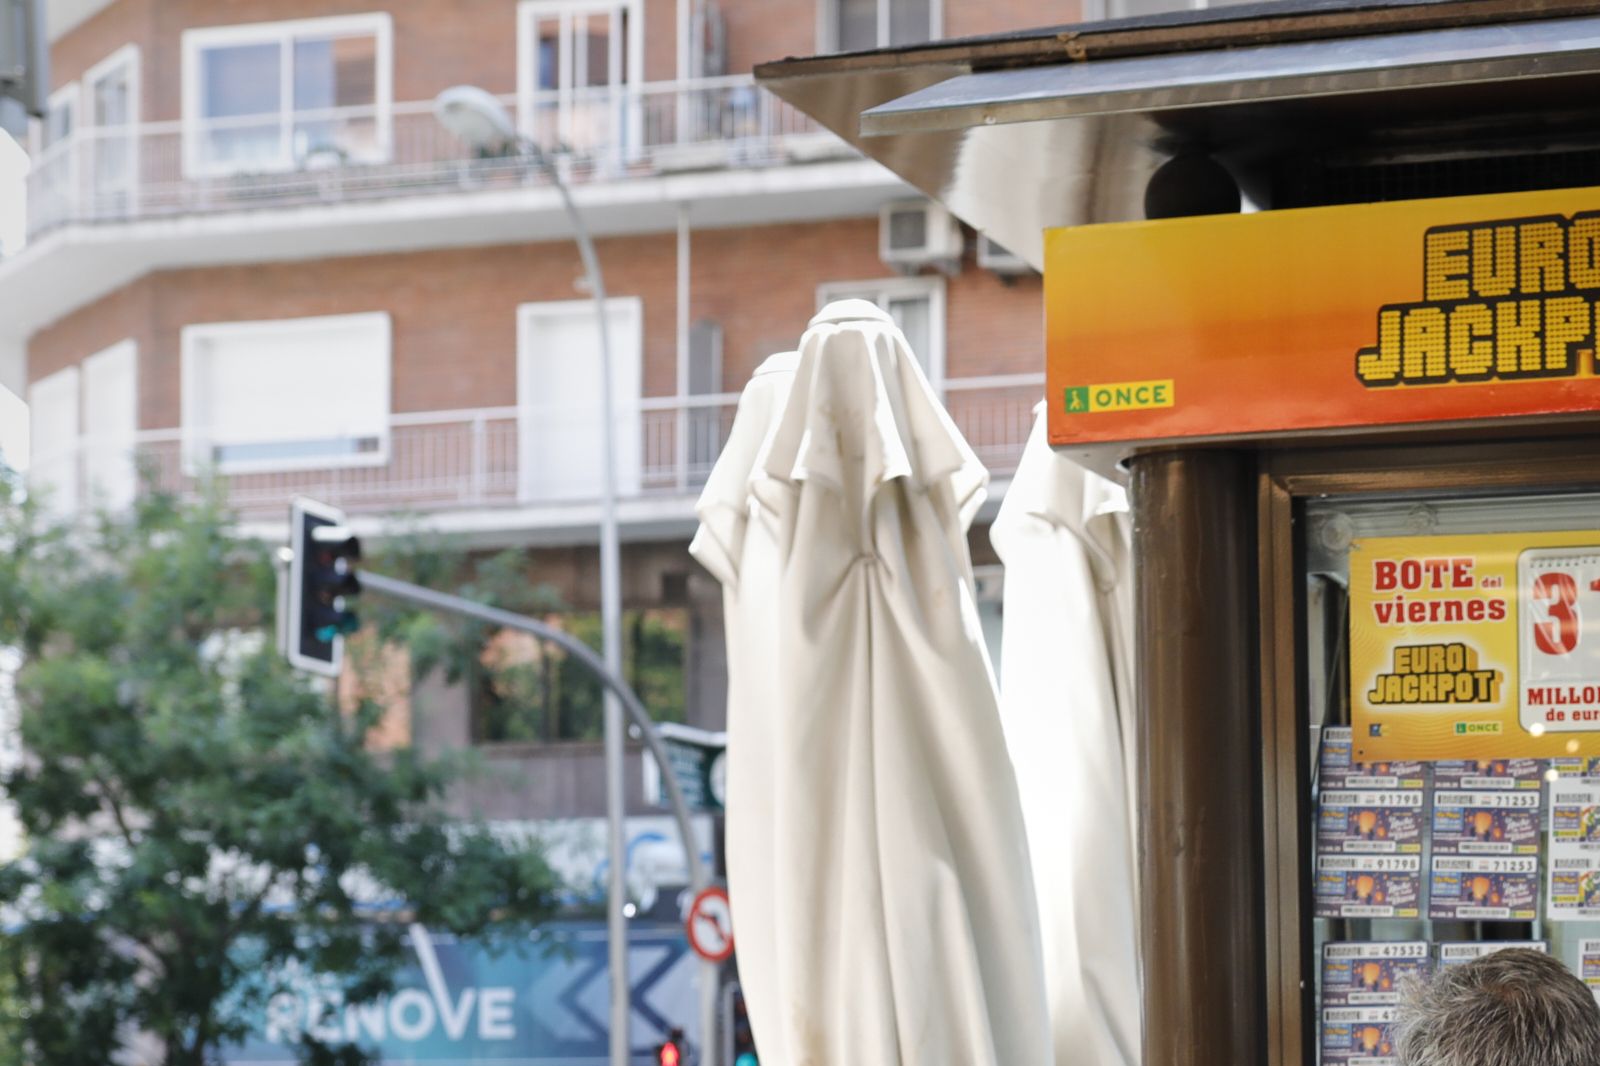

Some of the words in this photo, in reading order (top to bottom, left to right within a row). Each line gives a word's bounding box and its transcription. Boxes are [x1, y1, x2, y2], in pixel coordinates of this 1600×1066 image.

[1095, 385, 1167, 408] ONCE
[1374, 558, 1474, 591] BOTE
[1481, 576, 1503, 588] del
[1374, 595, 1506, 624] viernes
[1394, 643, 1467, 674] EURO
[1368, 671, 1496, 705] JACKPOT
[1546, 708, 1565, 721] de
[1468, 723, 1500, 733] ONCE
[1496, 796, 1536, 806] 71253
[1494, 861, 1534, 871] 71253
[1383, 945, 1423, 956] 47532
